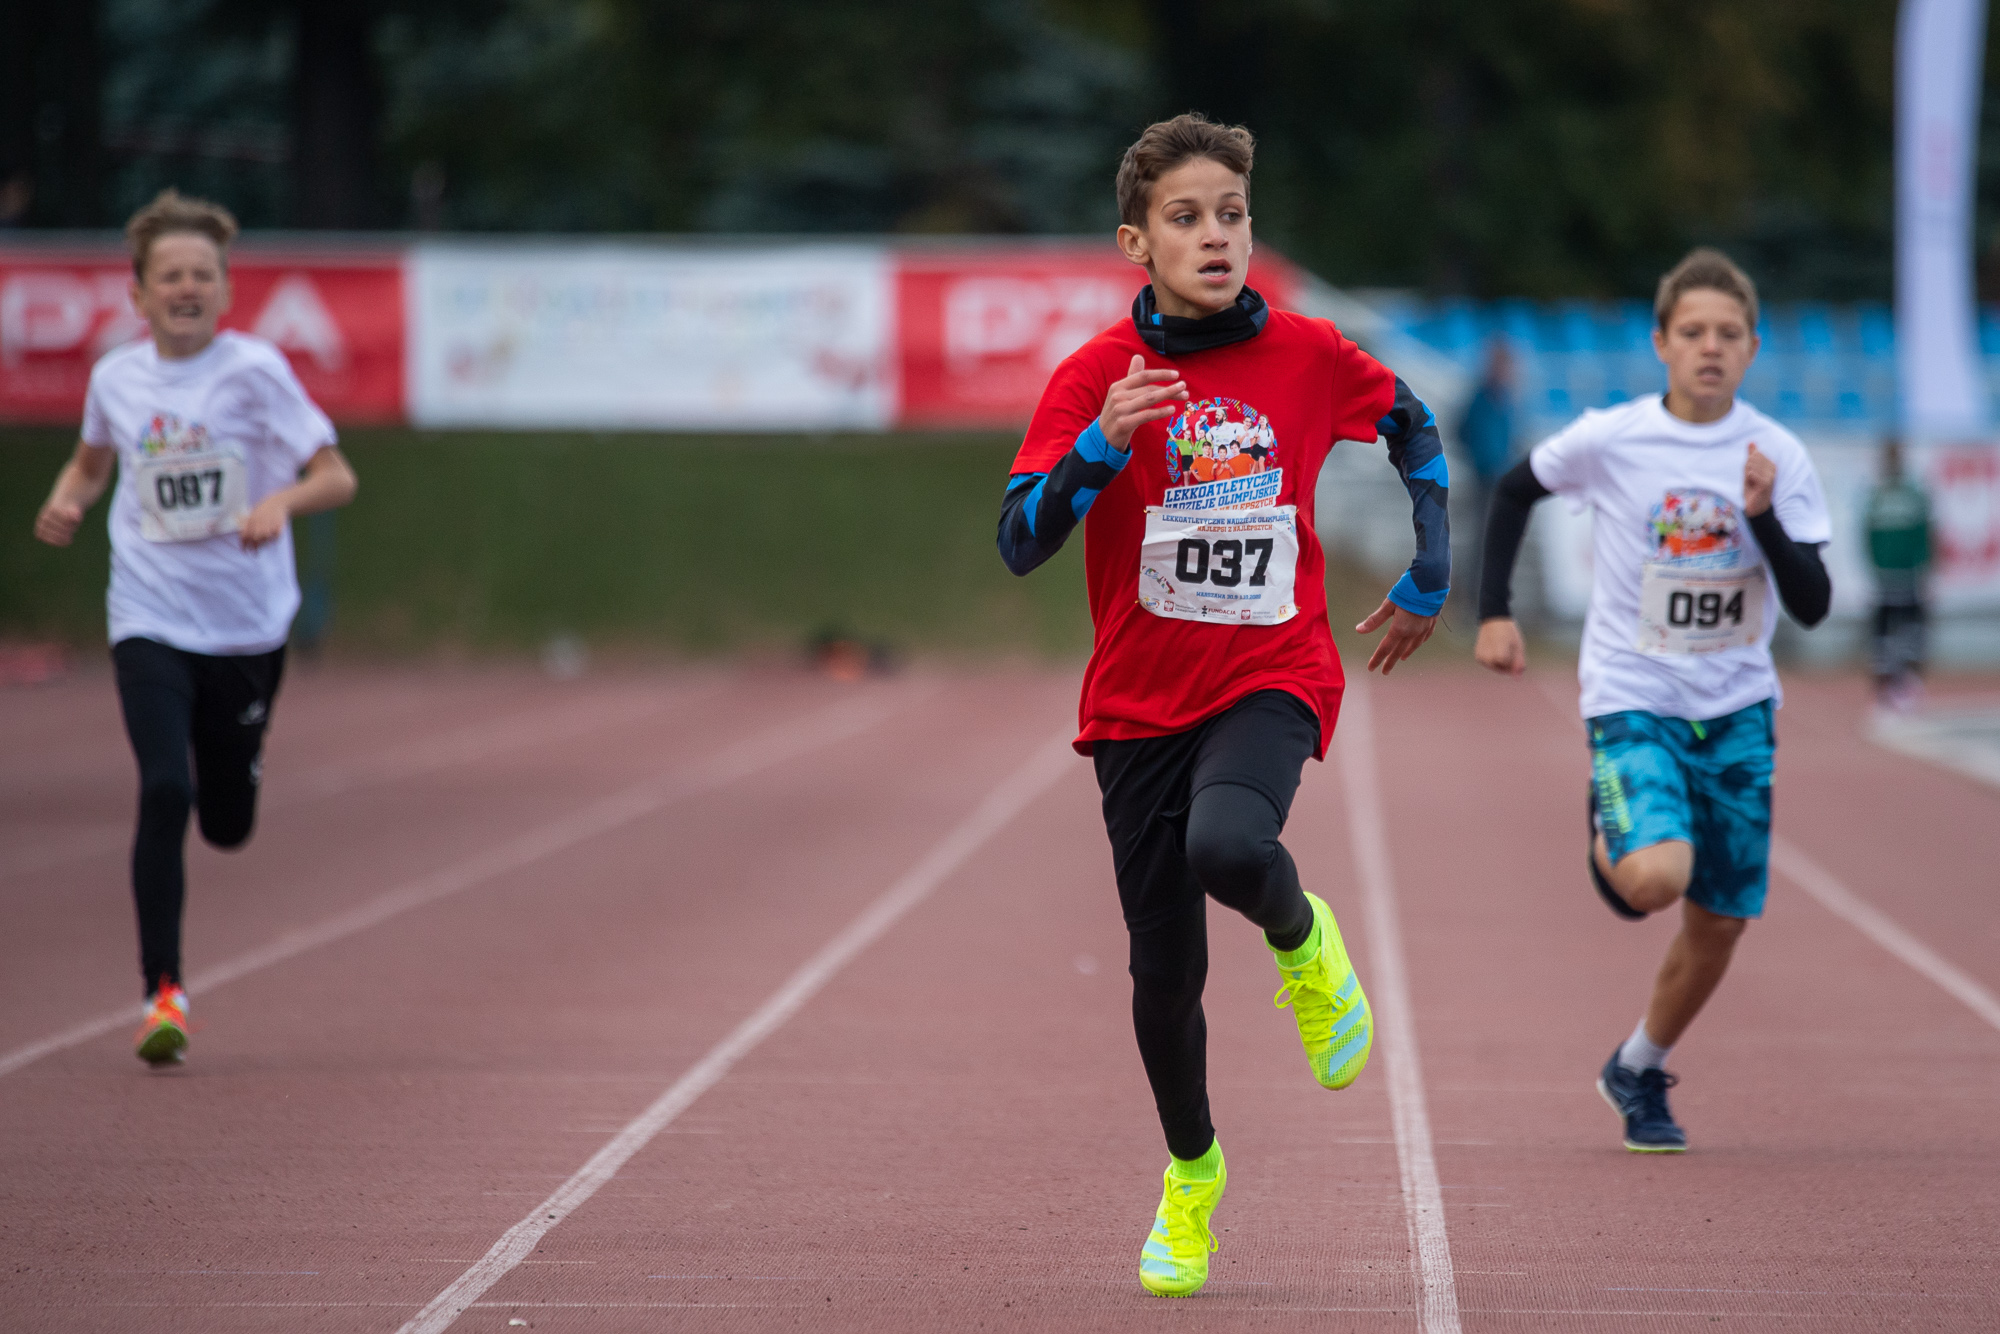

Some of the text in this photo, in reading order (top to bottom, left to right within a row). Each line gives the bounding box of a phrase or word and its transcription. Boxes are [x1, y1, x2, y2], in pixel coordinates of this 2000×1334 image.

[156, 469, 223, 511] 087
[1165, 470, 1281, 503] LEKKOATLETYCZNE
[1218, 484, 1279, 507] OLIMPIJSKIE
[1162, 514, 1225, 525] LEKKOATLETYCZNE
[1226, 516, 1257, 525] NADZIEJE
[1197, 525, 1227, 533] NAJLEPSI
[1233, 524, 1273, 532] NAJLEPSZYCH
[1175, 538, 1273, 587] 037
[1668, 589, 1745, 629] 094
